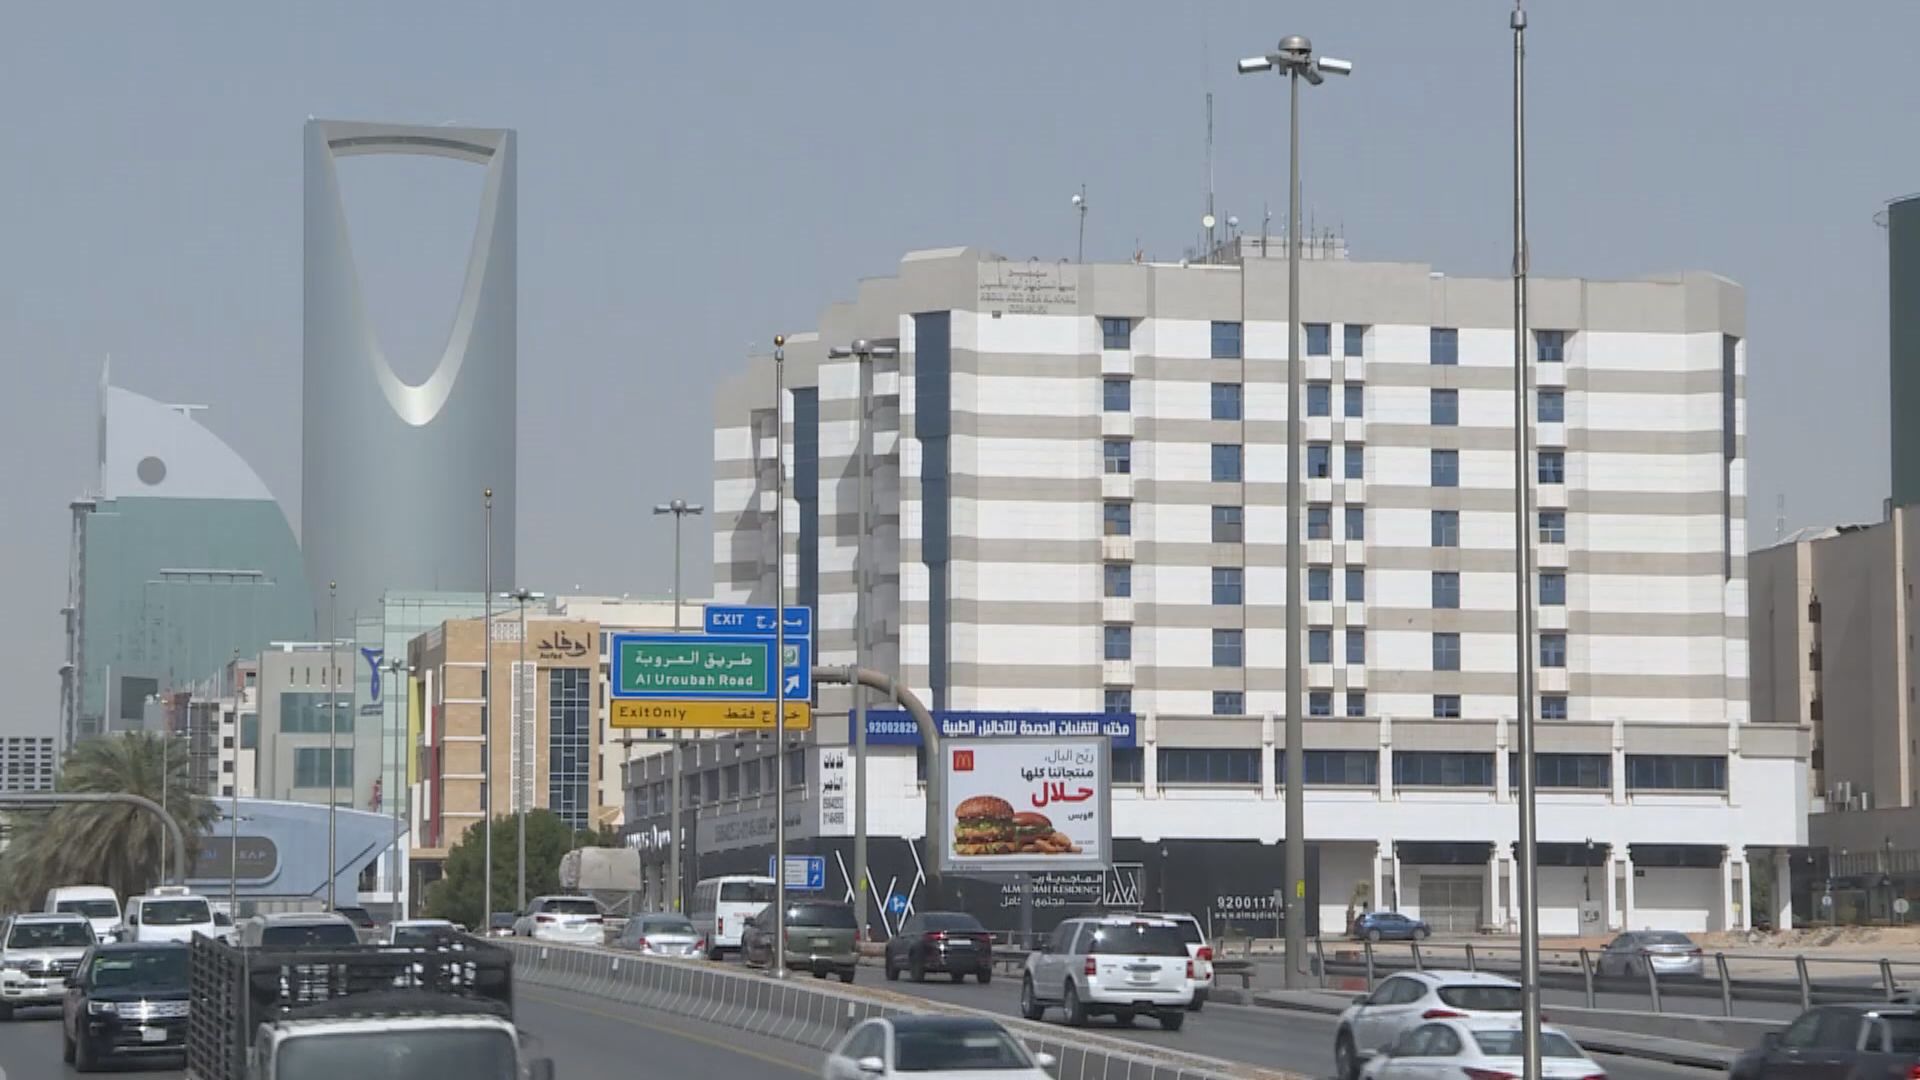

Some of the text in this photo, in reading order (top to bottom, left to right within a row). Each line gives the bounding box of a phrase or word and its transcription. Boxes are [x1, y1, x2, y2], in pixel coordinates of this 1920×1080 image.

[712, 613, 745, 626] EXIT
[635, 649, 753, 669] طريق العروبة
[635, 674, 753, 686] Al Uroubah Road
[723, 704, 755, 719] فقط
[1021, 766, 1094, 781] منتجاتنا كلها
[1032, 782, 1094, 807] حلال
[1053, 884, 1101, 894] RESIDENCE
